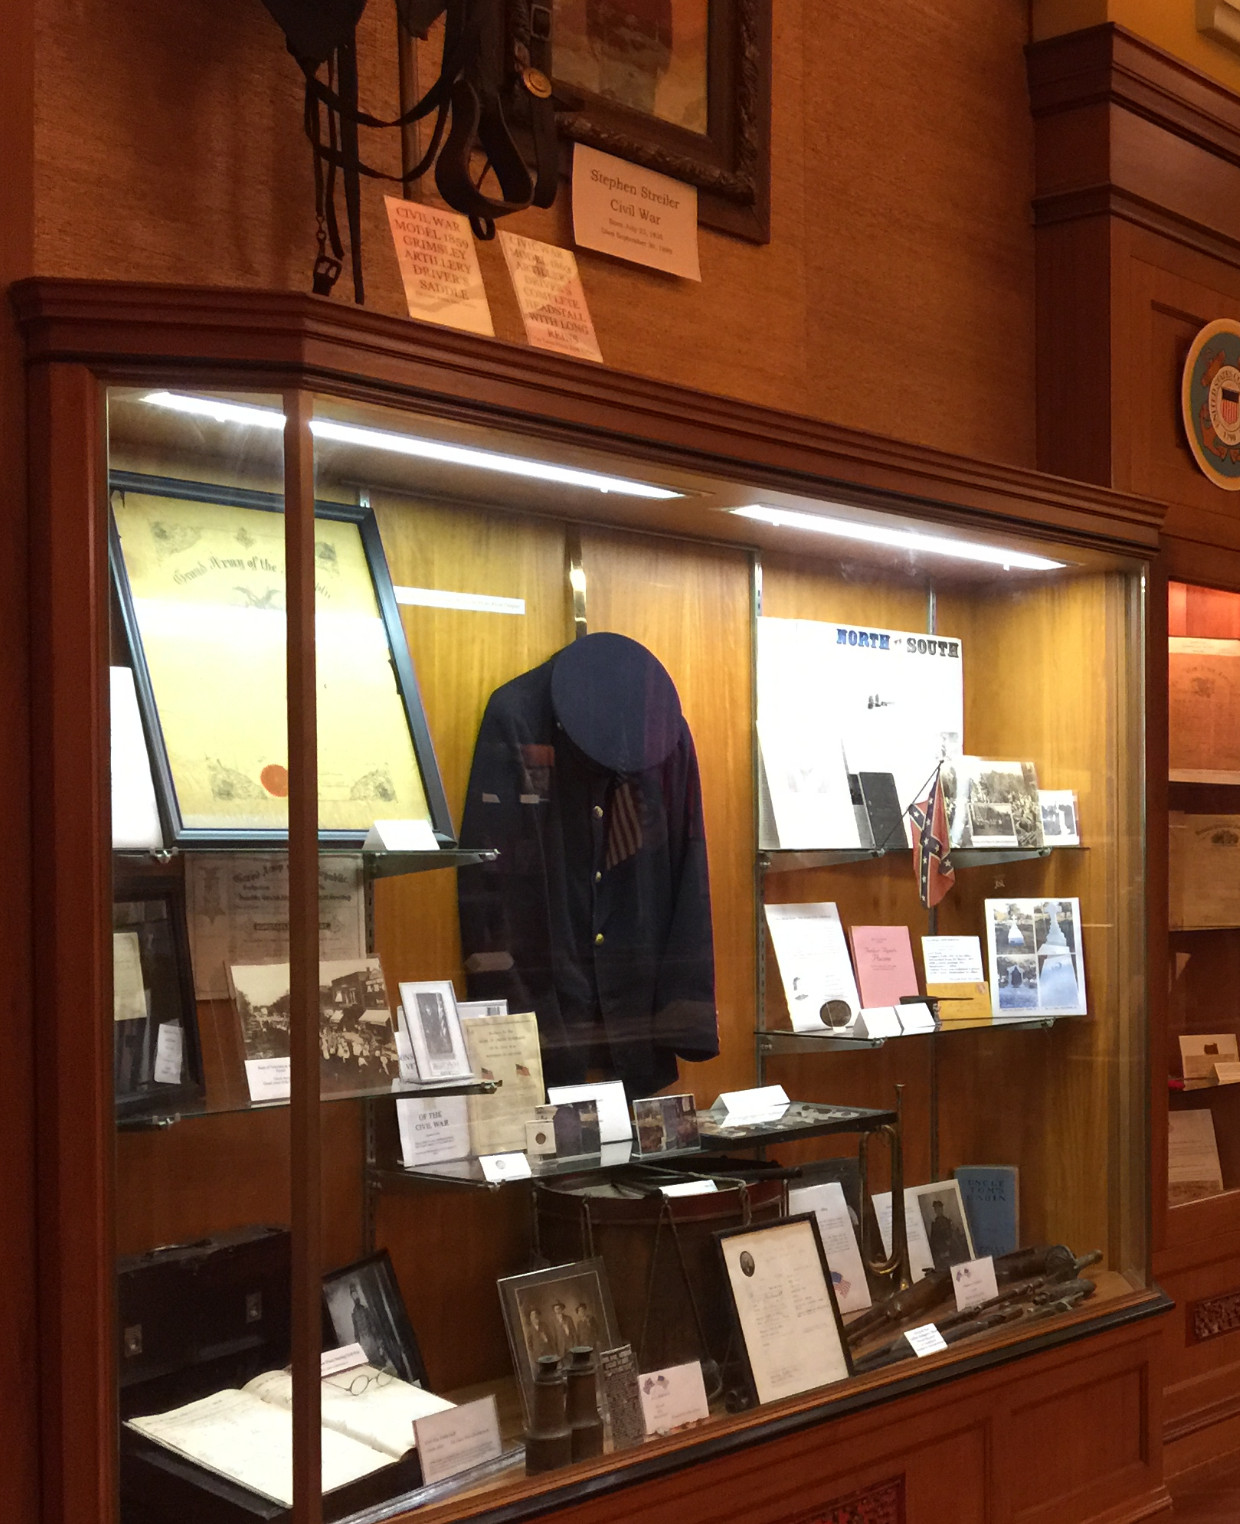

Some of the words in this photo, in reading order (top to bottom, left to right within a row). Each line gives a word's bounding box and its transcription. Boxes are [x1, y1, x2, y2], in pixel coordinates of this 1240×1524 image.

[591, 169, 637, 196] Stephen
[396, 207, 431, 223] CIVIL
[432, 215, 460, 232] WAR
[610, 199, 636, 217] Civil
[639, 207, 662, 225] War
[394, 219, 440, 240] MODEL
[419, 280, 470, 300] SADDLE
[247, 556, 259, 571] of
[260, 558, 277, 572] the
[836, 628, 891, 650] NORTH
[906, 637, 960, 659] SOUTH
[433, 1119, 450, 1128] WAR
